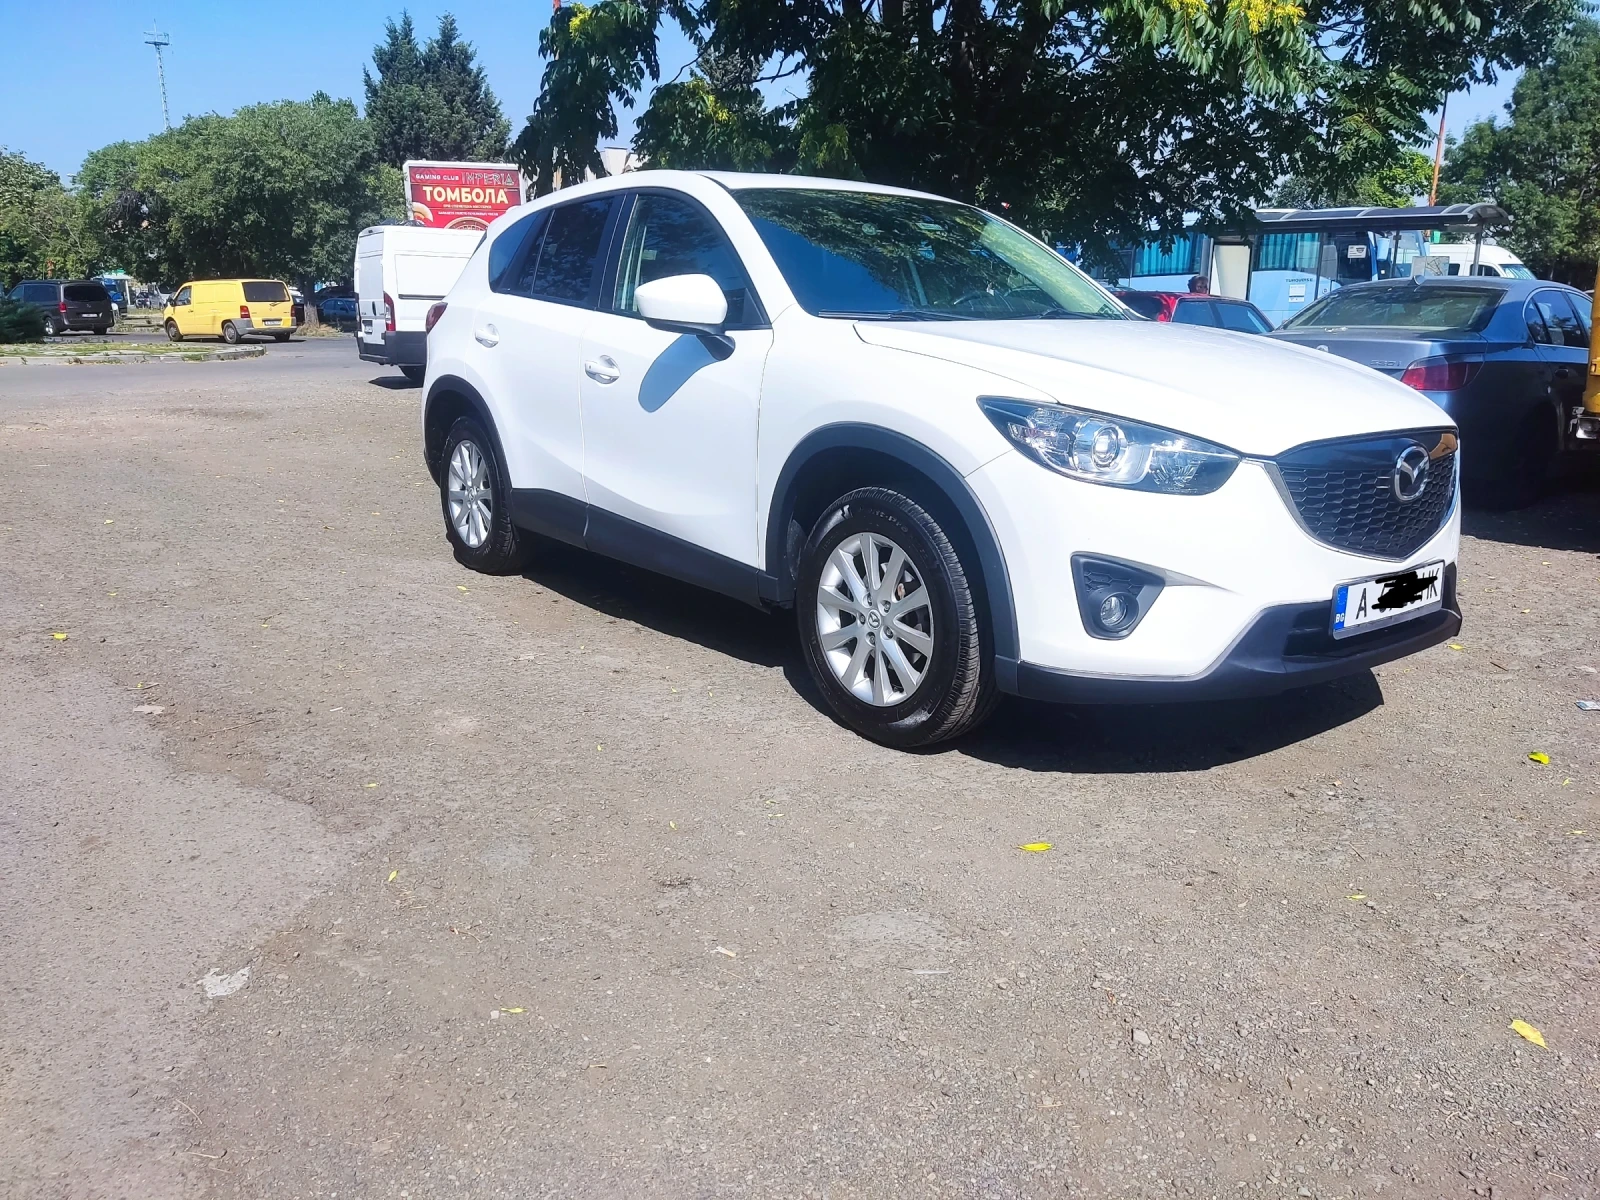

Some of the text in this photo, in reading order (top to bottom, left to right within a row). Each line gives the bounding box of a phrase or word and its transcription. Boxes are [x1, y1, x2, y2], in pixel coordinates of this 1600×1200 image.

[461, 172, 514, 186] IMPERIA
[422, 185, 508, 204] ТОМБОЛА
[1355, 587, 1367, 620] A
[1335, 612, 1345, 623] BG
